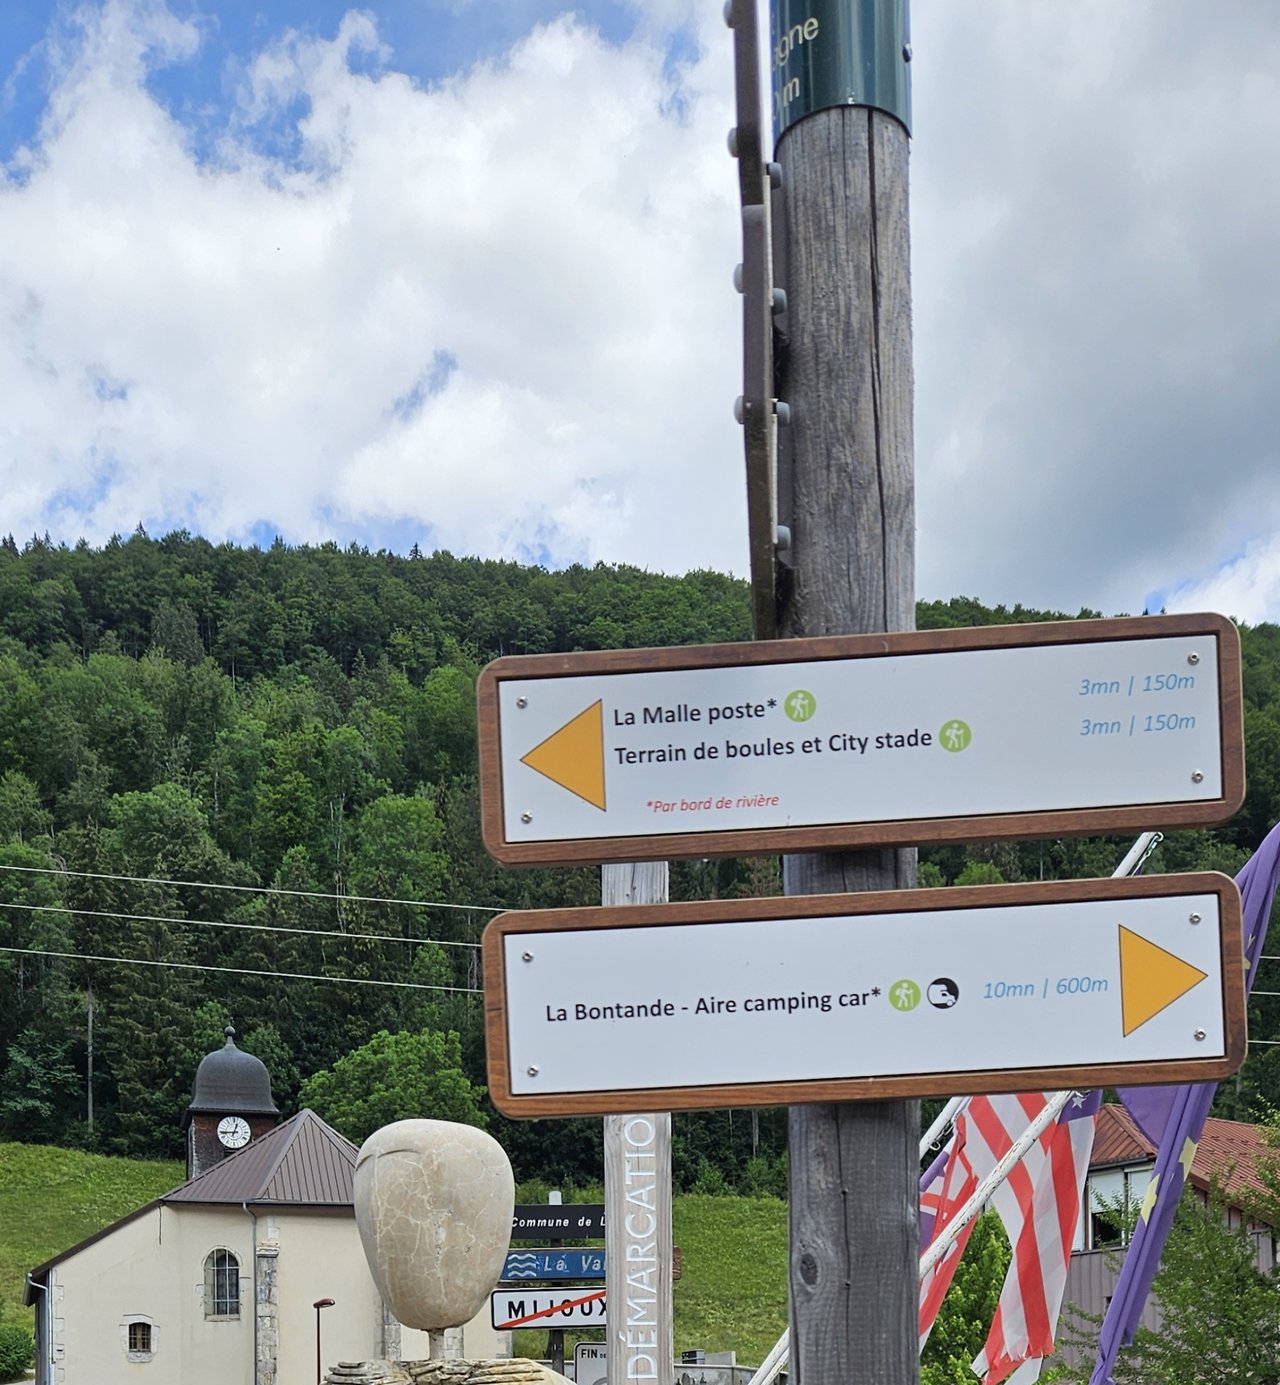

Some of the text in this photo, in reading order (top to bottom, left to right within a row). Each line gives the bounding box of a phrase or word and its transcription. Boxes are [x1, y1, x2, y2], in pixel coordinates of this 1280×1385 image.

[776, 17, 819, 66] gne
[1079, 678, 1120, 697] 3mn
[1142, 673, 1195, 692] 150m
[614, 709, 636, 726] La
[644, 704, 701, 724] Malle
[1080, 718, 1121, 736] 3mn
[1143, 713, 1196, 732] 150m
[614, 728, 933, 765] Terrain de boules et City stade
[680, 796, 711, 811] bord
[715, 796, 733, 810] de
[736, 793, 780, 809] rivière
[983, 981, 1034, 999] 10mn
[1056, 976, 1108, 995] 600m
[546, 1005, 567, 1022] La
[575, 999, 675, 1021] Bontande
[695, 996, 737, 1015] Aire
[744, 991, 832, 1014] camping
[512, 1216, 570, 1228] Commune
[578, 1215, 592, 1227] de
[618, 1115, 658, 1379] DÉMARCATIO
[543, 1254, 607, 1273] La Va
[507, 1297, 607, 1320] MIJOUX
[581, 1349, 598, 1358] FIN
